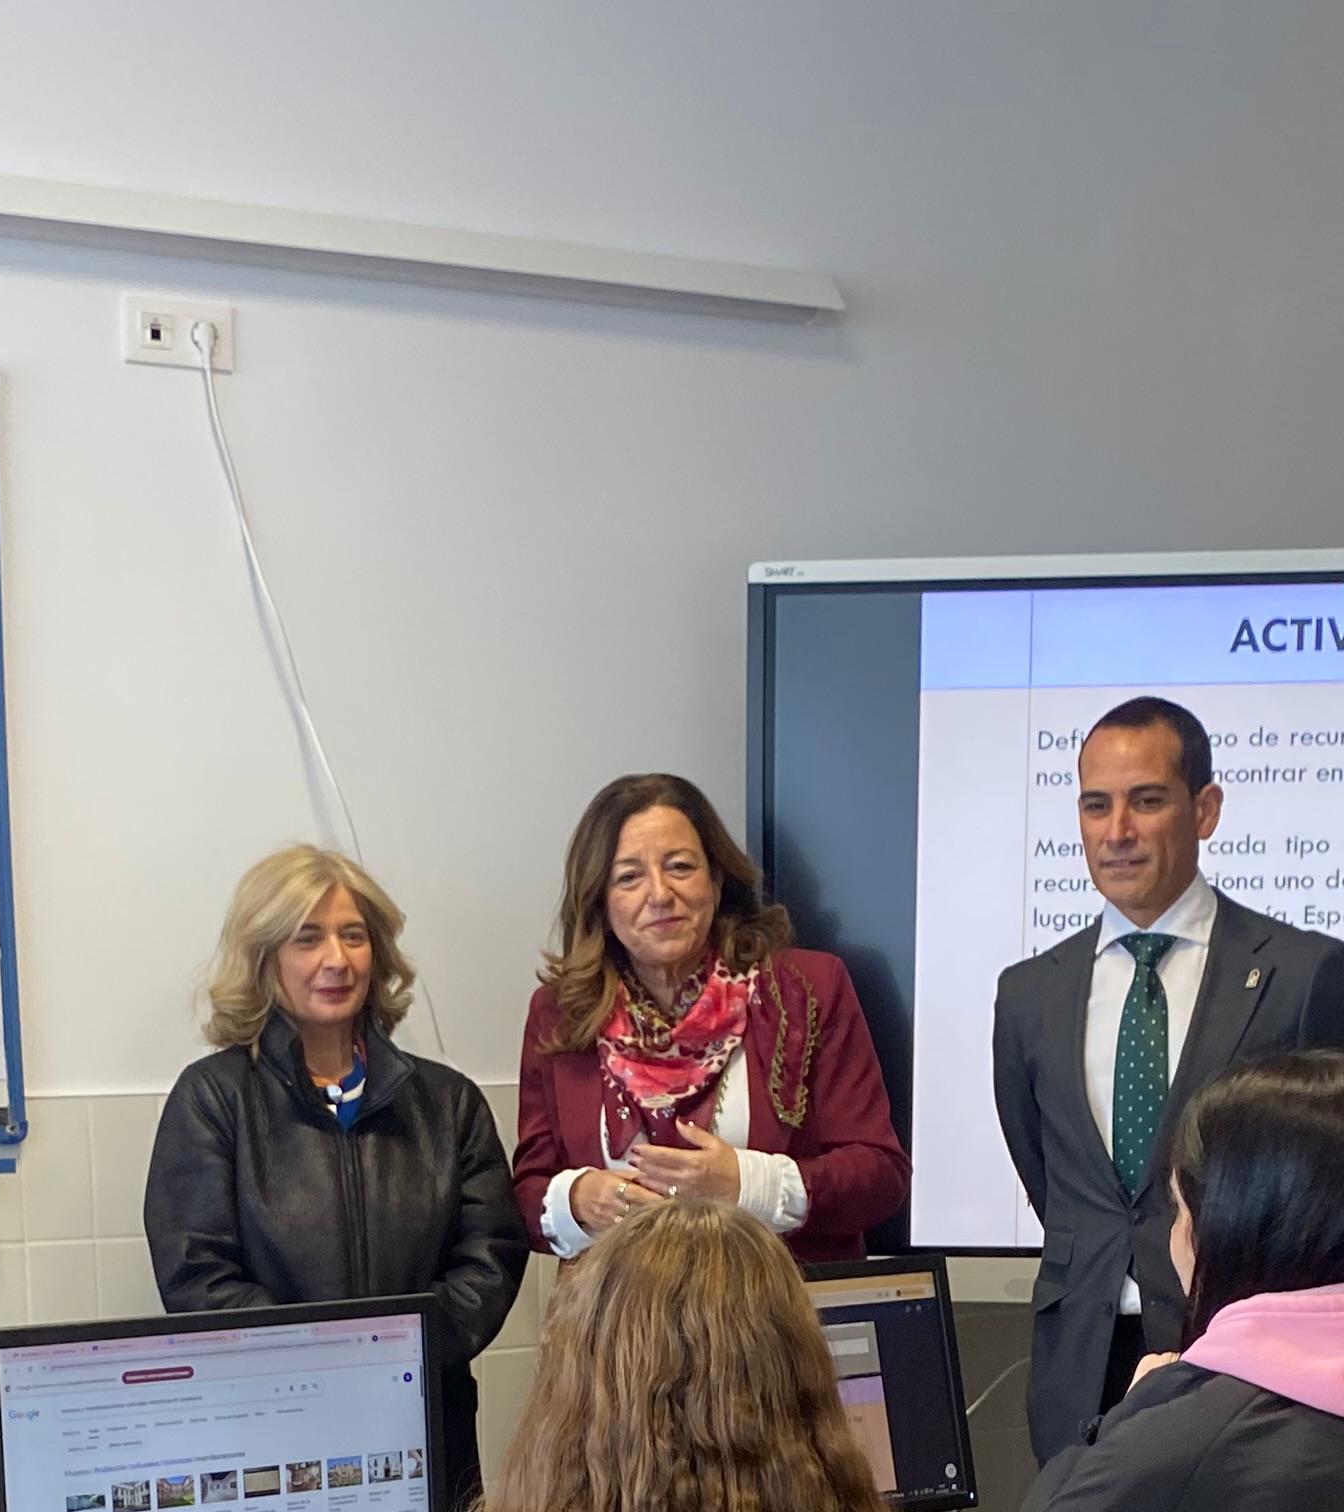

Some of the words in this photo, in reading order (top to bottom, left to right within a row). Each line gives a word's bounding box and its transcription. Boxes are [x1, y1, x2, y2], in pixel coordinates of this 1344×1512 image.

[1210, 733, 1238, 748] po
[1249, 726, 1279, 746] de
[1036, 769, 1073, 787] nos
[1211, 765, 1307, 783] ncontrar
[1316, 767, 1343, 782] en
[1033, 838, 1084, 858] Men
[1207, 834, 1266, 855] cada
[1285, 835, 1330, 860] tipo
[1274, 874, 1315, 890] uno
[8, 1408, 40, 1421] Google
